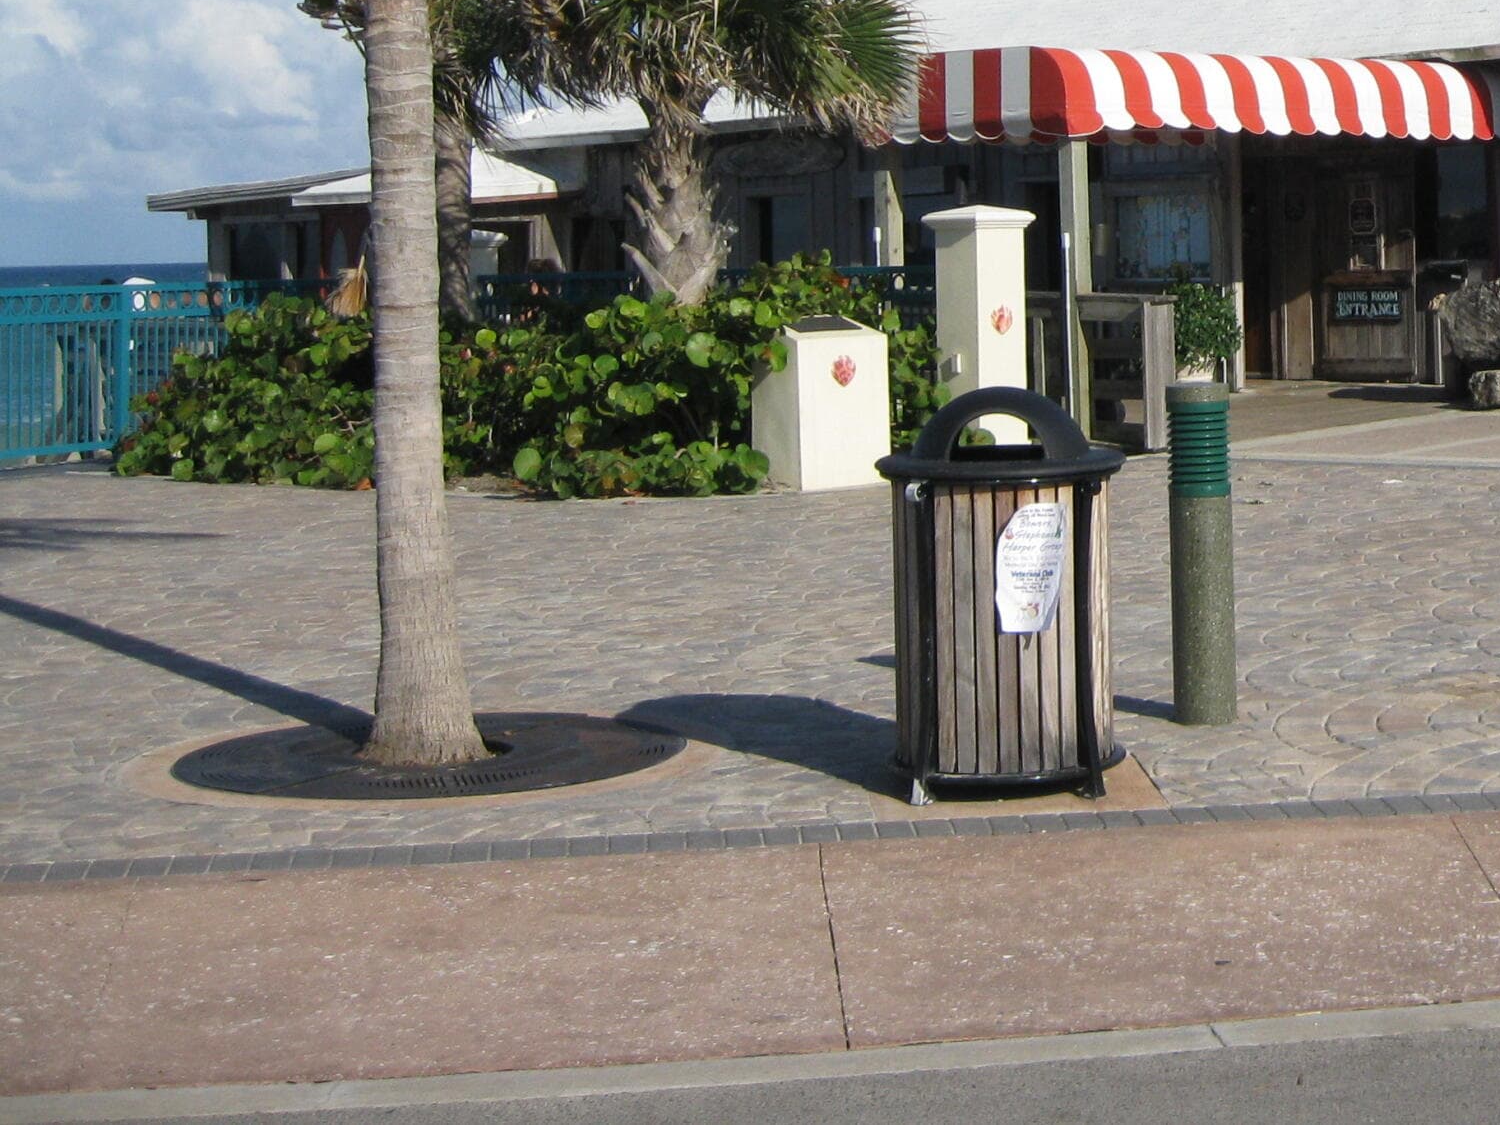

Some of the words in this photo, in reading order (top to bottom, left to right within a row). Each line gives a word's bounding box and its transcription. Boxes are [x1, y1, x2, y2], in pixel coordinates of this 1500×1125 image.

[1338, 291, 1368, 301] DINING
[1371, 291, 1398, 301] ROOM
[1336, 302, 1399, 318] ENTRANCE
